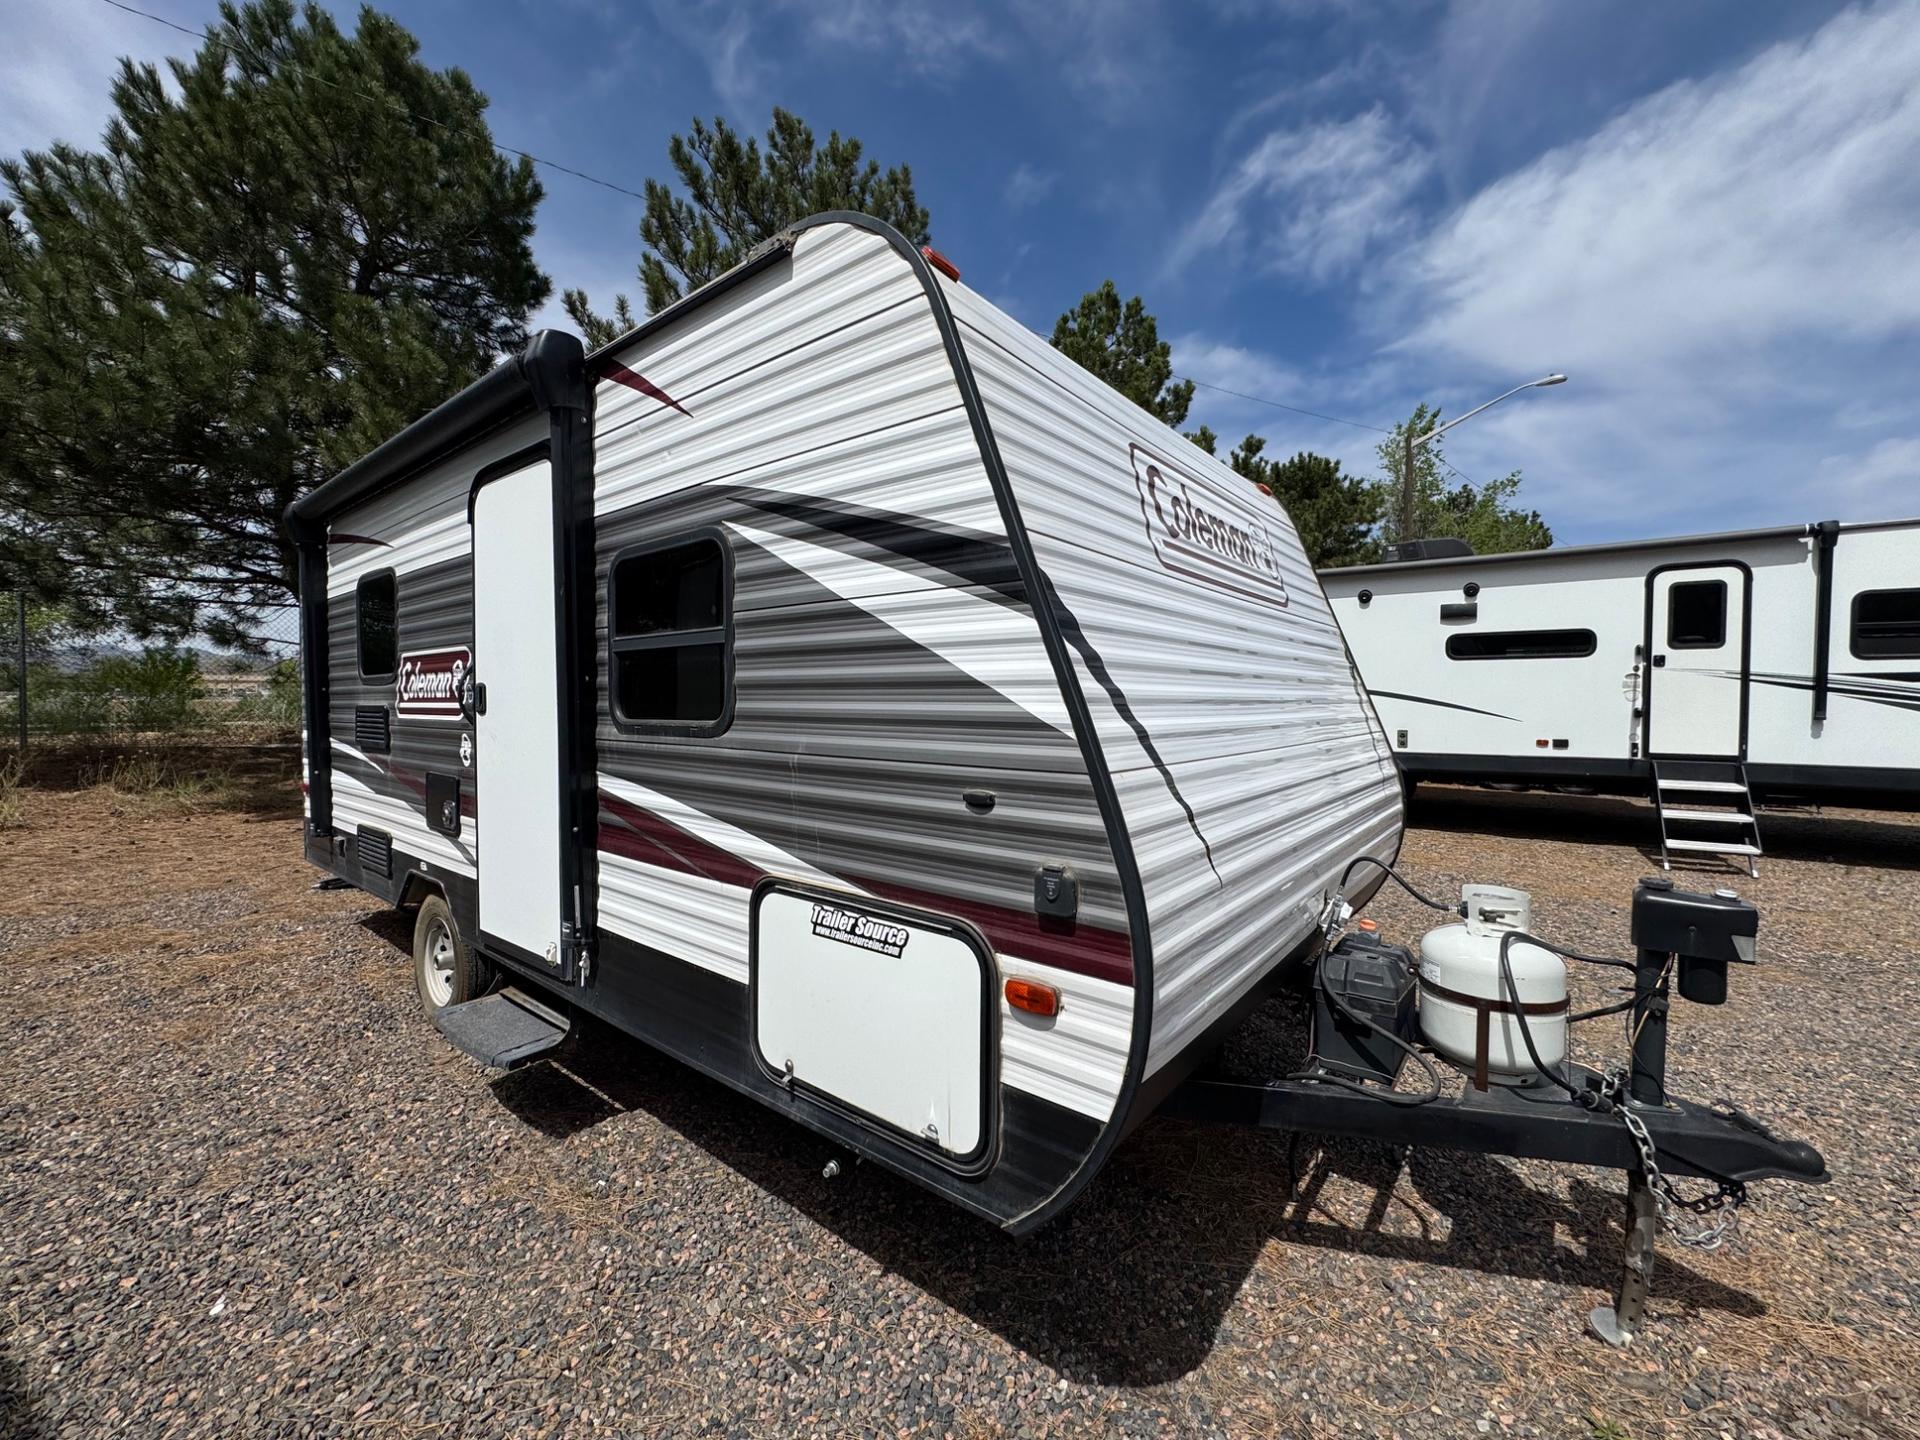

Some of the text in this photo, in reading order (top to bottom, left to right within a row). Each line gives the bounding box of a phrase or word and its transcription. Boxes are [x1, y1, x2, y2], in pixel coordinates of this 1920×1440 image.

[1146, 464, 1261, 570] Coleman
[400, 661, 452, 701] Coleman
[812, 905, 907, 946] Trailer Source
[815, 925, 900, 956] www.trailersourceinc.com
